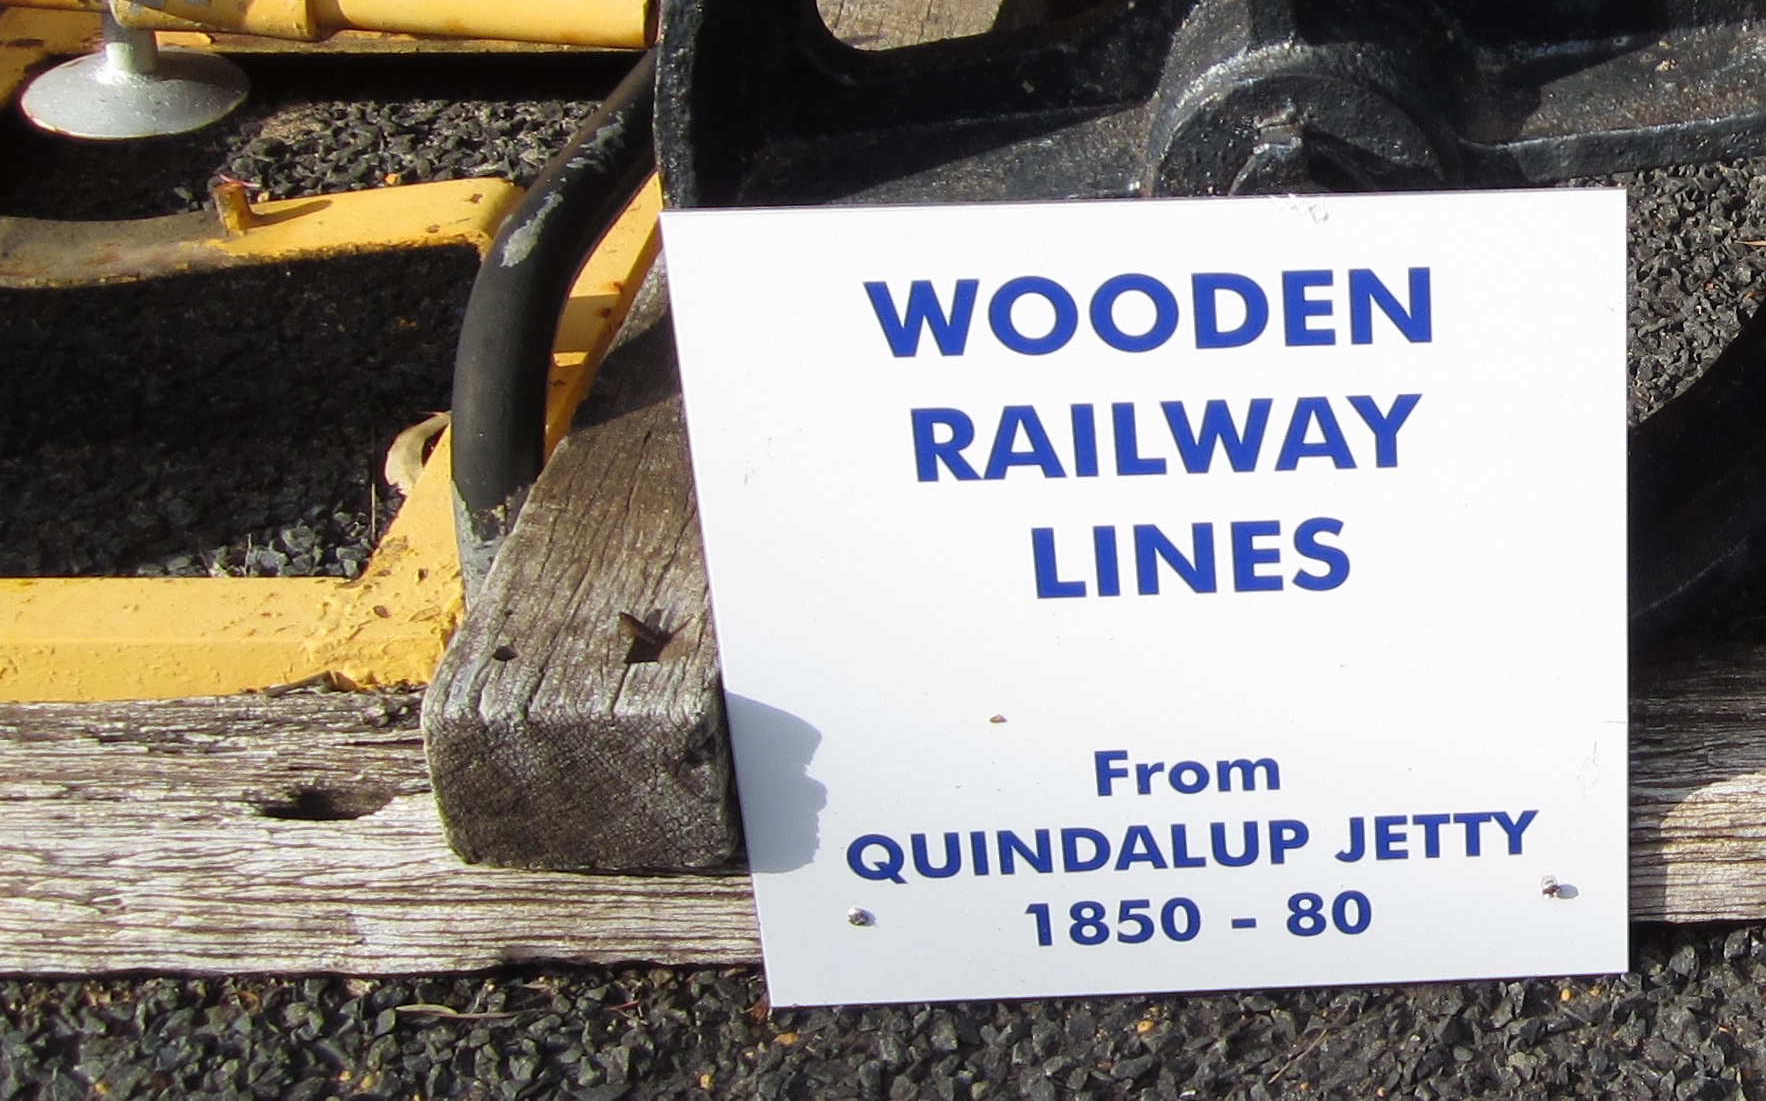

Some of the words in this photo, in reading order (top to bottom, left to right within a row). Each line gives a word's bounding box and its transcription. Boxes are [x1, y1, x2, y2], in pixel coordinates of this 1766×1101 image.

[863, 267, 1433, 358] WOODEN
[910, 393, 1422, 483] RAILWAY
[1031, 516, 1351, 599] LINES
[1094, 749, 1282, 797] From
[846, 820, 1311, 884] QUINDALUP
[1336, 809, 1538, 863] JETTY
[1025, 898, 1202, 947] 1850
[1286, 890, 1373, 937] 80
